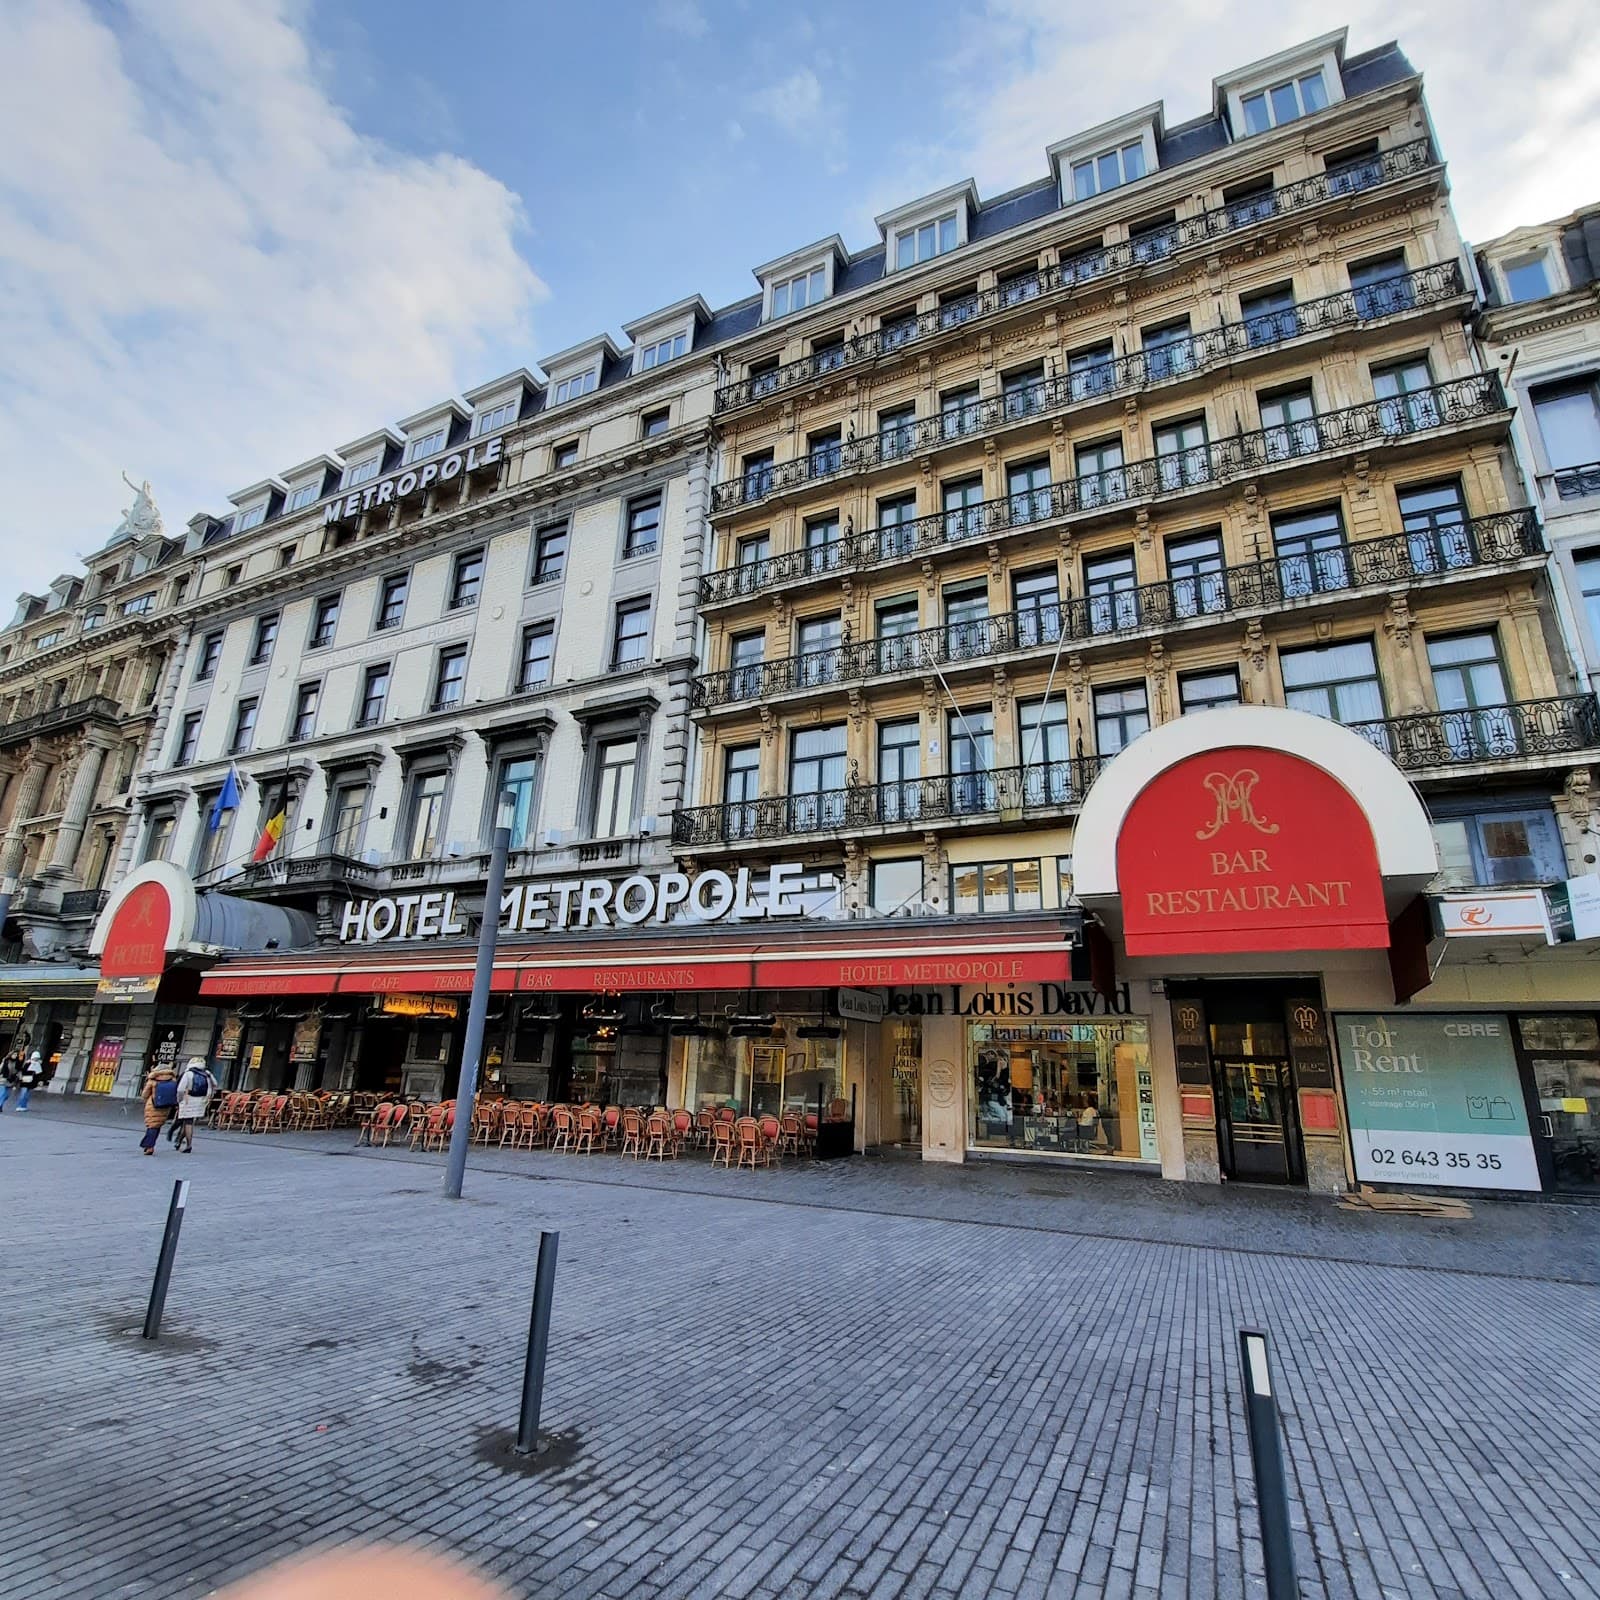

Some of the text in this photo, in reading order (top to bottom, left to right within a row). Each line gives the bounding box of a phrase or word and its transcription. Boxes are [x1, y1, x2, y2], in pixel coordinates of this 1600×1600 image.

[322, 437, 503, 525] METROPOLE
[427, 616, 469, 640] HOTEL
[1210, 849, 1272, 876] BAR
[339, 863, 804, 941] HOTEL METROPOLE
[1147, 881, 1352, 916] RESTAURANT
[112, 943, 156, 966] HOTEL
[371, 975, 475, 989] CAFE TERRA
[526, 969, 695, 987] BAR RESTAURANTS
[840, 961, 1024, 982] HOTEL METROPOLE
[882, 981, 1133, 1016] Jean Louis David
[985, 1024, 1021, 1041] Jean
[1078, 1024, 1125, 1041] David
[1348, 1023, 1502, 1048] For CBRE
[93, 1066, 118, 1077] OPEN
[893, 1056, 917, 1067] Louis
[1353, 1049, 1424, 1073] Rent
[892, 1067, 918, 1079] David
[1371, 1148, 1502, 1170] 02 643 35 35
